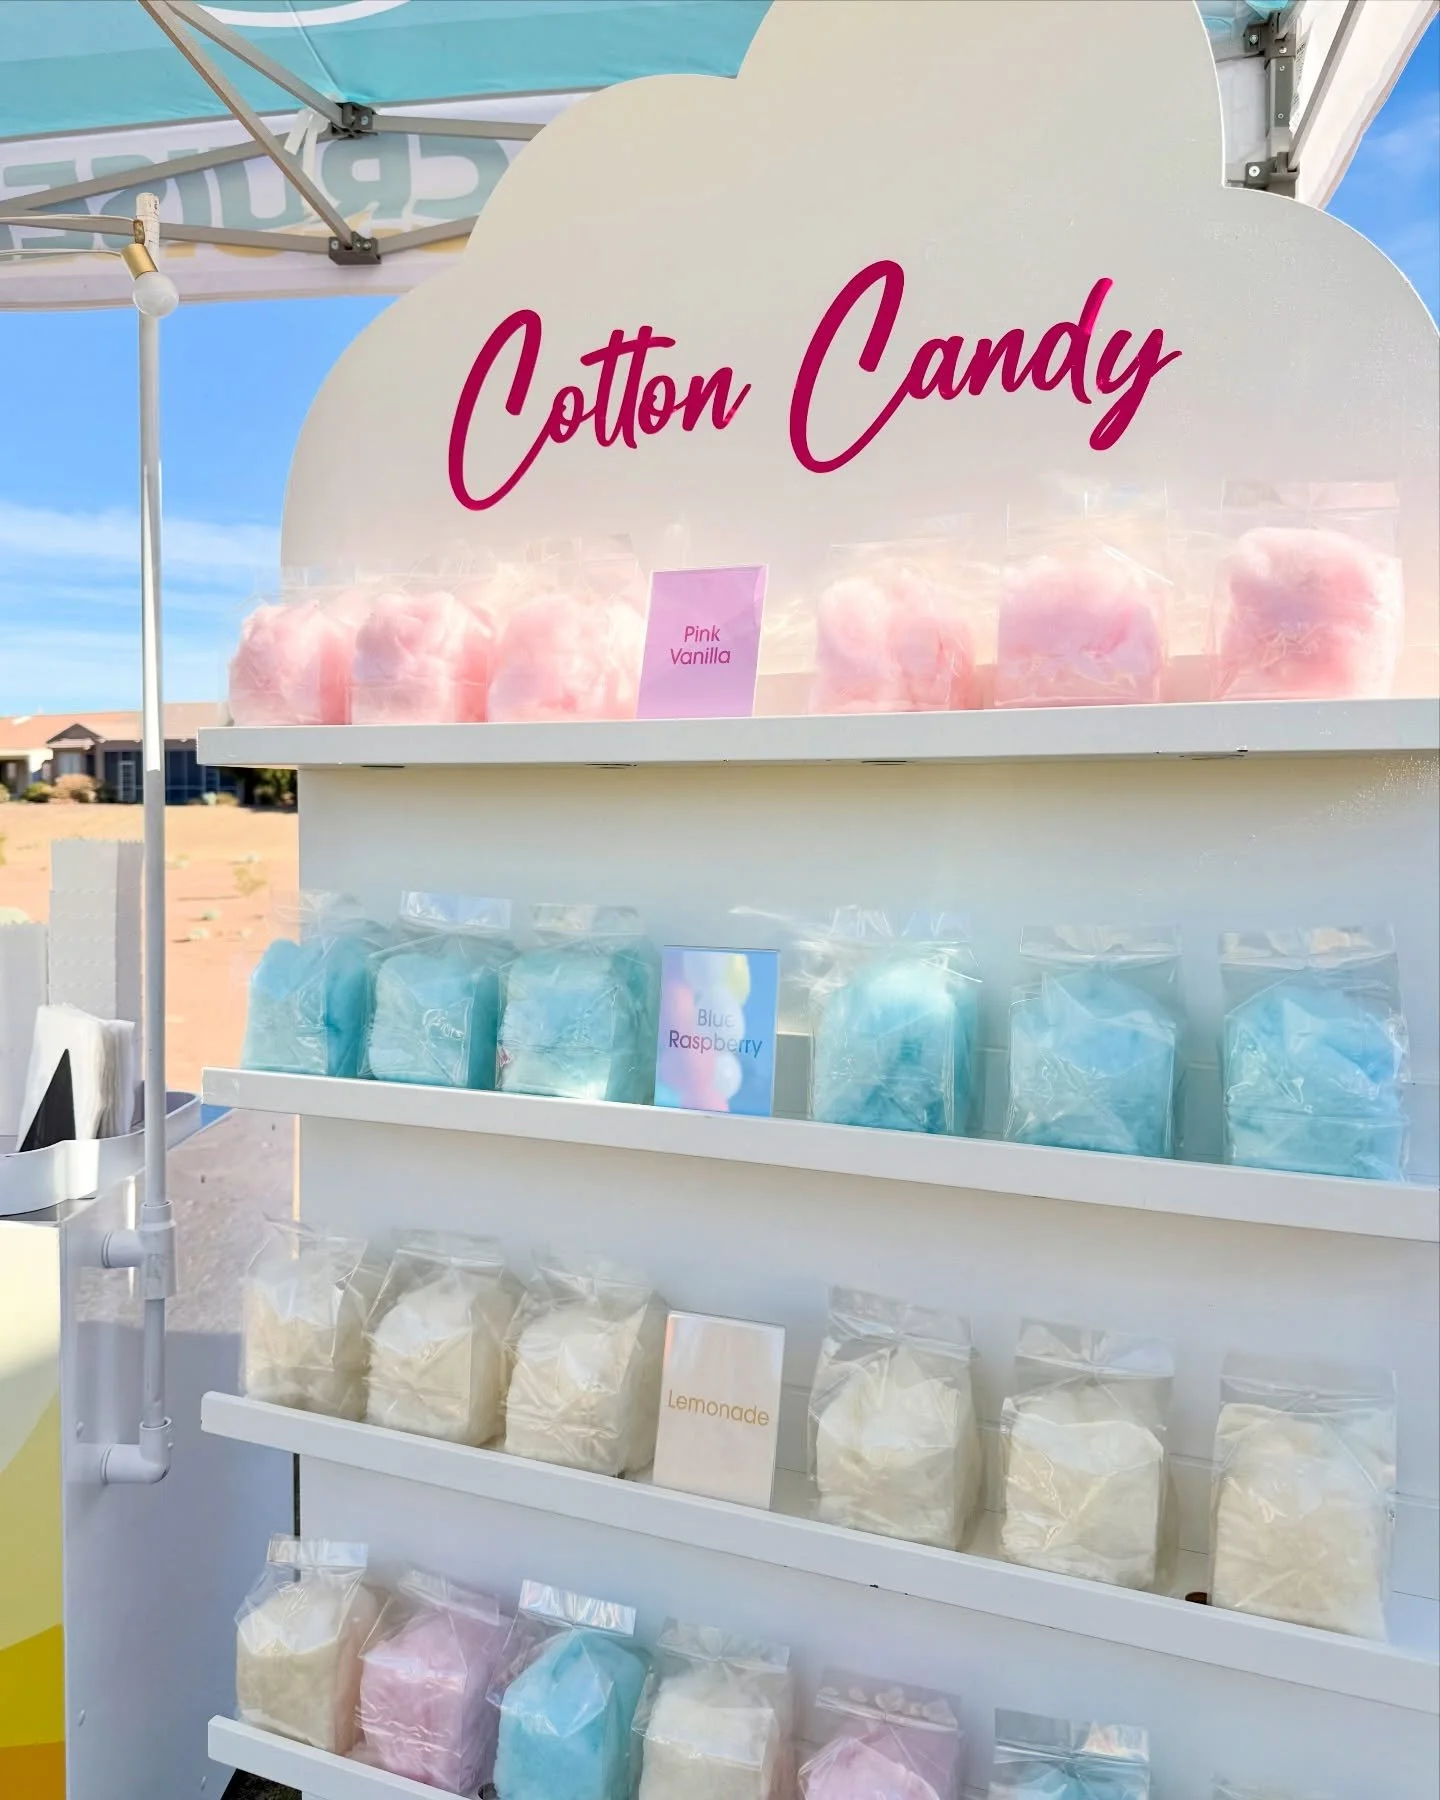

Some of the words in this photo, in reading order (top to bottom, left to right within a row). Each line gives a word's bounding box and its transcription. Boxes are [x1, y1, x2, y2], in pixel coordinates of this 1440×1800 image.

[448, 310, 749, 511] Cotton
[790, 260, 1181, 473] Candy
[684, 625, 720, 642] Pink
[670, 647, 731, 665] Vanilla
[697, 1008, 735, 1027] Blue
[669, 1030, 762, 1058] Raspberry
[667, 1389, 770, 1427] Lemonade
